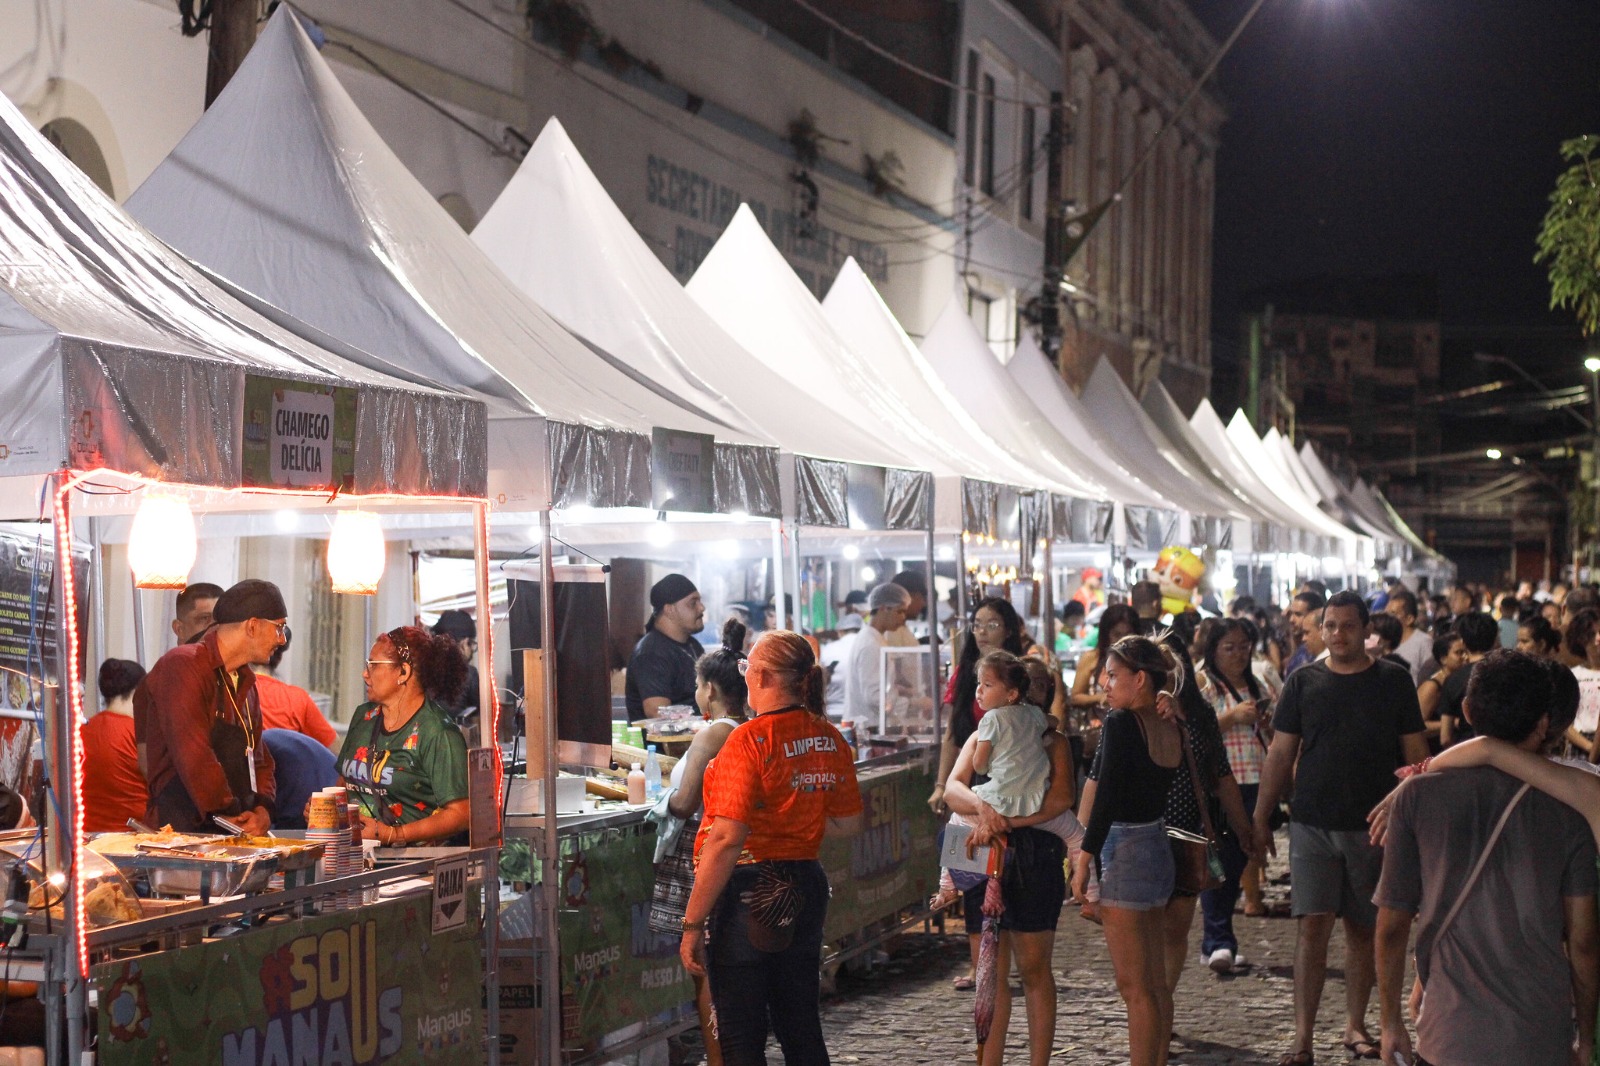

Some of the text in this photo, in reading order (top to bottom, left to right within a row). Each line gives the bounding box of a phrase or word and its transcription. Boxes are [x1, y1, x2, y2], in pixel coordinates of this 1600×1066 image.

[275, 409, 330, 440] CHAMEGO
[281, 438, 322, 472] DELÍCIA
[784, 736, 838, 758] LIMPEZA
[438, 868, 463, 899] CAIXA
[574, 945, 621, 974] Manaus
[640, 967, 673, 989] PASSO
[675, 964, 683, 983] A
[417, 1007, 472, 1040] Manaus
